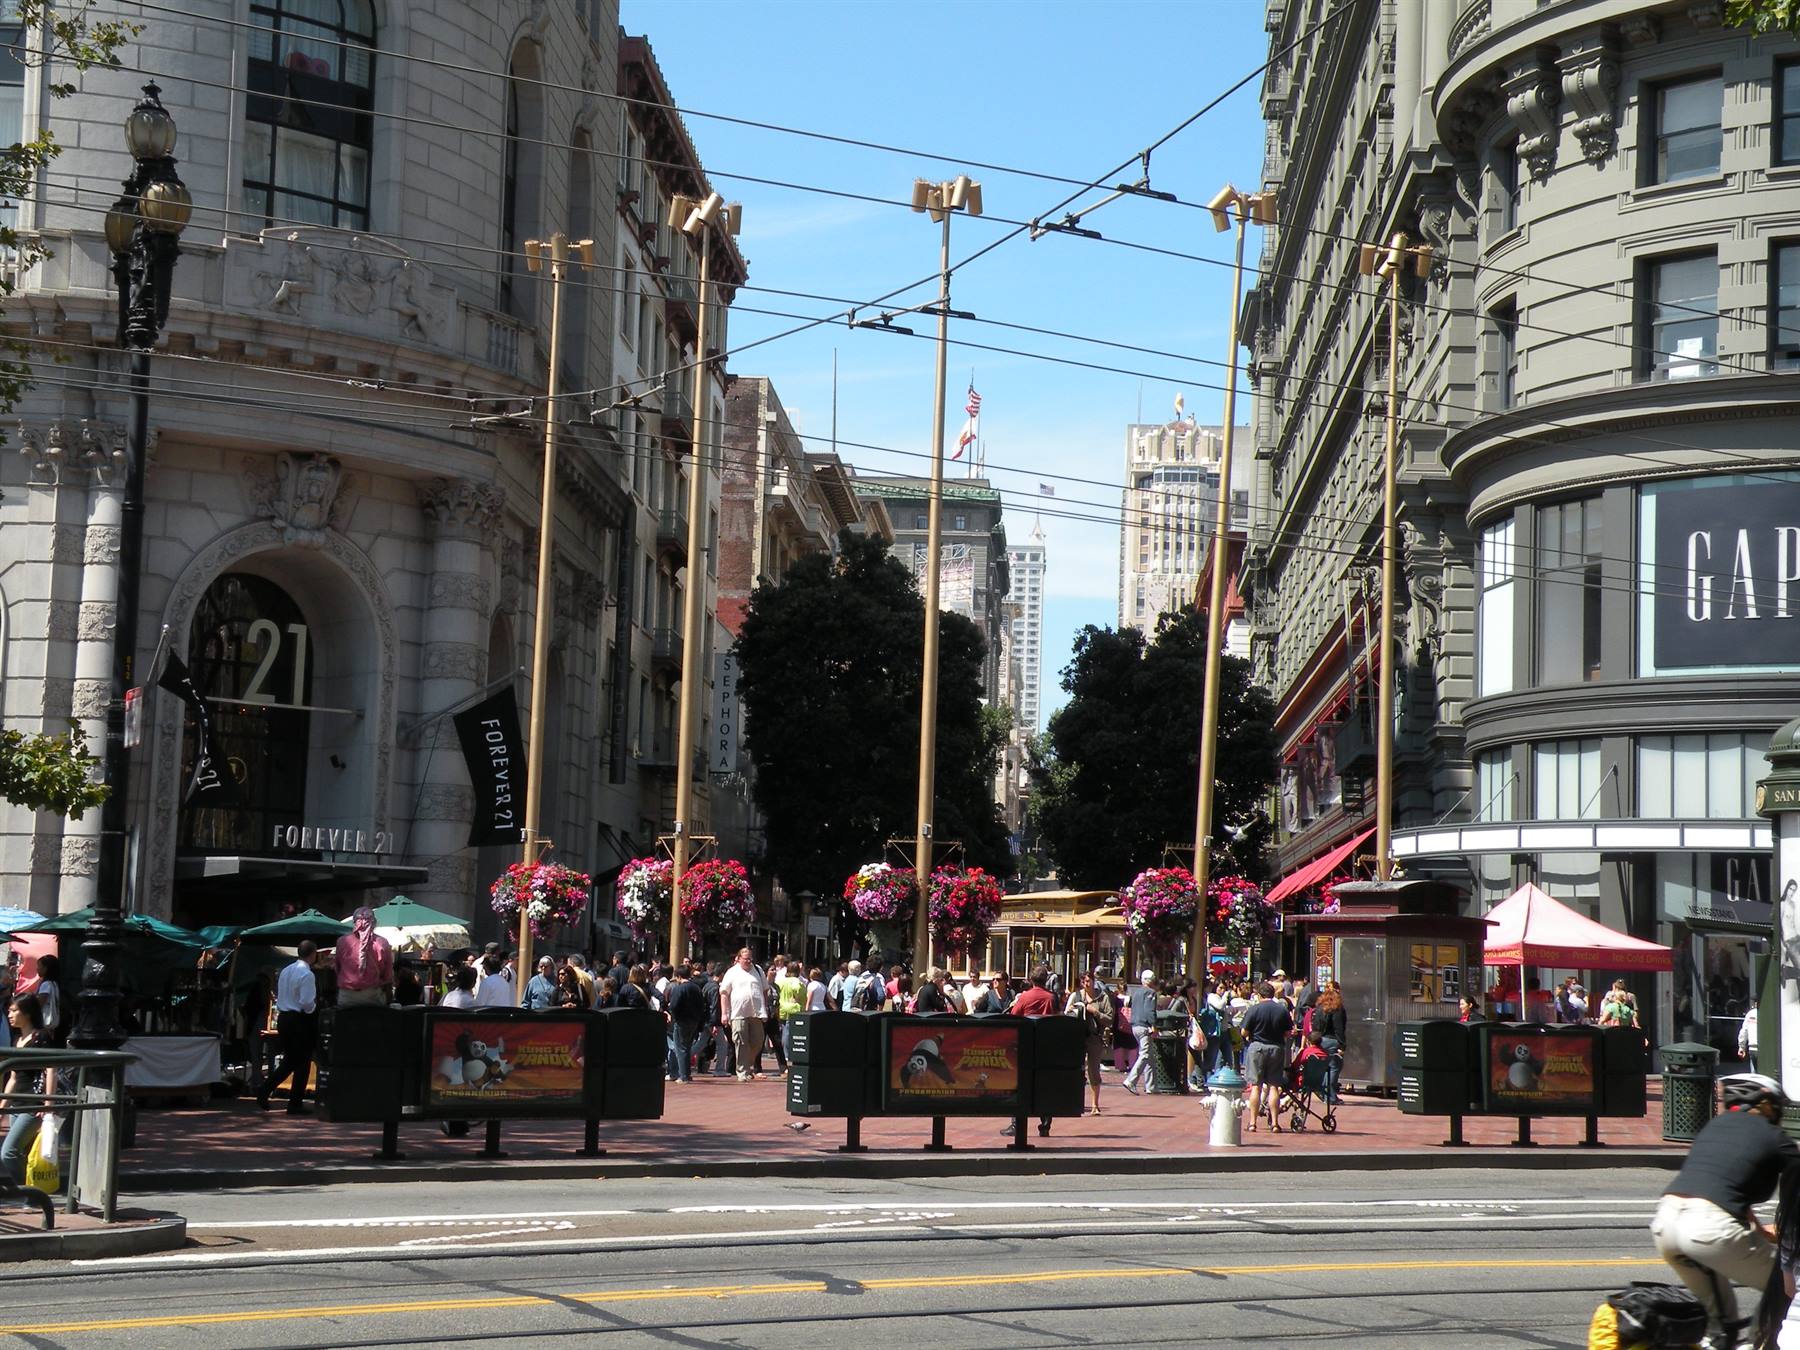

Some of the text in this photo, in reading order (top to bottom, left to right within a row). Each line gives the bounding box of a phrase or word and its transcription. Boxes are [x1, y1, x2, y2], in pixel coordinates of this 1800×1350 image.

[1686, 526, 1800, 623] GAP
[243, 618, 308, 707] 21
[614, 688, 626, 760] HOTEL
[718, 658, 731, 768] SEPHORA
[481, 719, 511, 806] FOREVER
[1774, 789, 1795, 802] SAN
[272, 824, 394, 854] FOREVER 21
[1726, 858, 1774, 903] GA
[1541, 949, 1561, 960] Dogs
[1612, 952, 1624, 961] Ice
[1628, 953, 1644, 963] Cold
[513, 1053, 577, 1069] PANDA
[518, 1045, 569, 1054] KUNG FU
[954, 1056, 1014, 1071] PANDA
[963, 1048, 1007, 1056] KUNG FU
